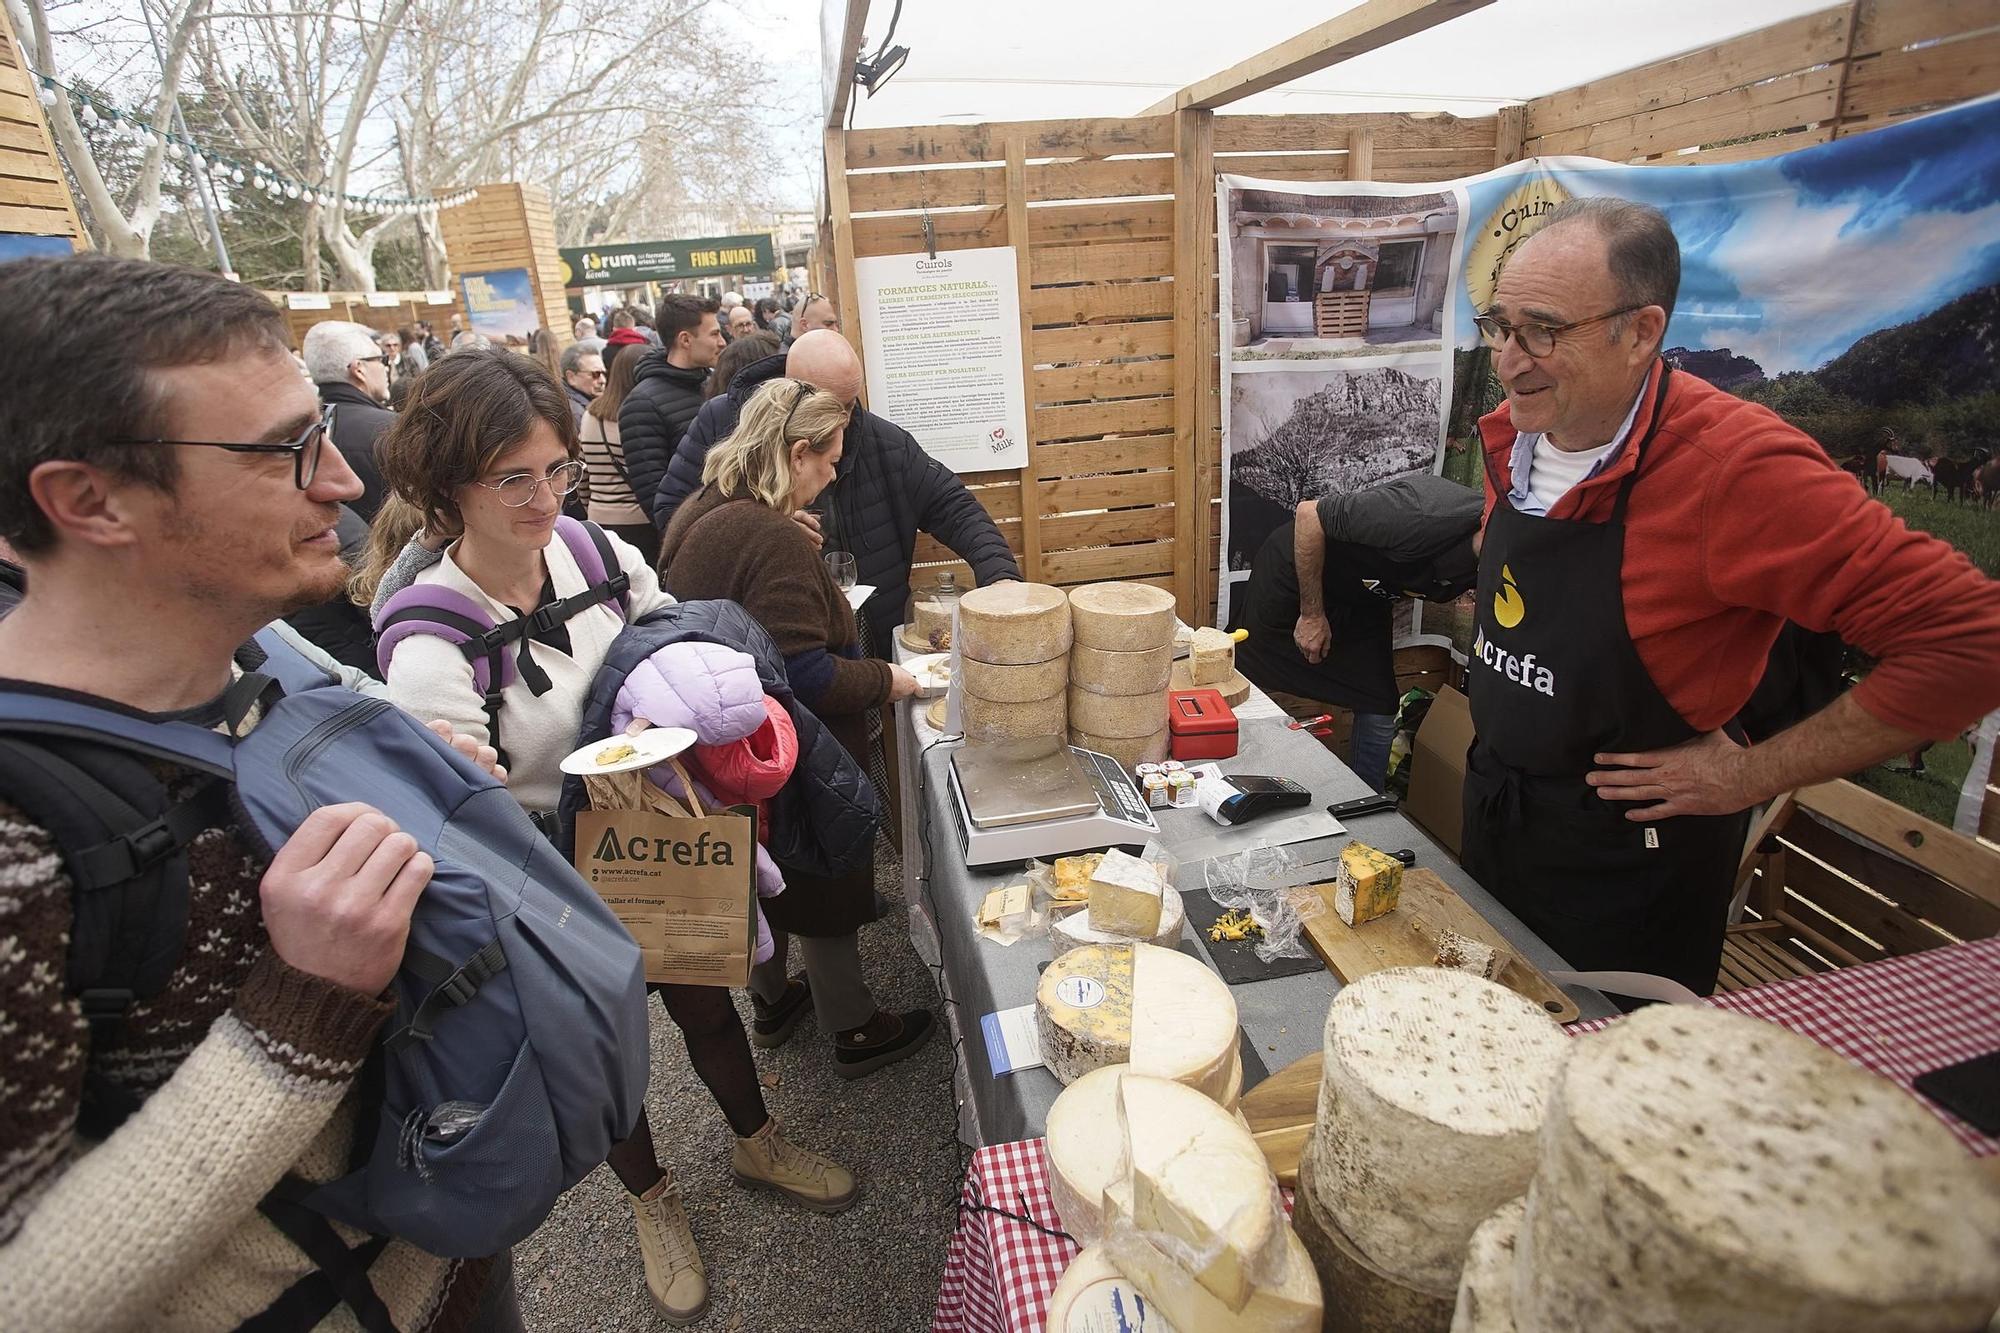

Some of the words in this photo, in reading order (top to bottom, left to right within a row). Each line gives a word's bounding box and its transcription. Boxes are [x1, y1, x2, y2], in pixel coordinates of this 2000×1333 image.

[690, 250, 717, 268] FINS
[719, 248, 757, 265] AVIAT!
[915, 259, 952, 270] Cuirols
[878, 284, 937, 296] FORMATGES
[991, 438, 1014, 454] Milk
[1473, 624, 1554, 697] Acrefa
[592, 827, 734, 867] Acrefa
[601, 869, 662, 877] www.acrefa.cat
[635, 897, 665, 906] formatge
